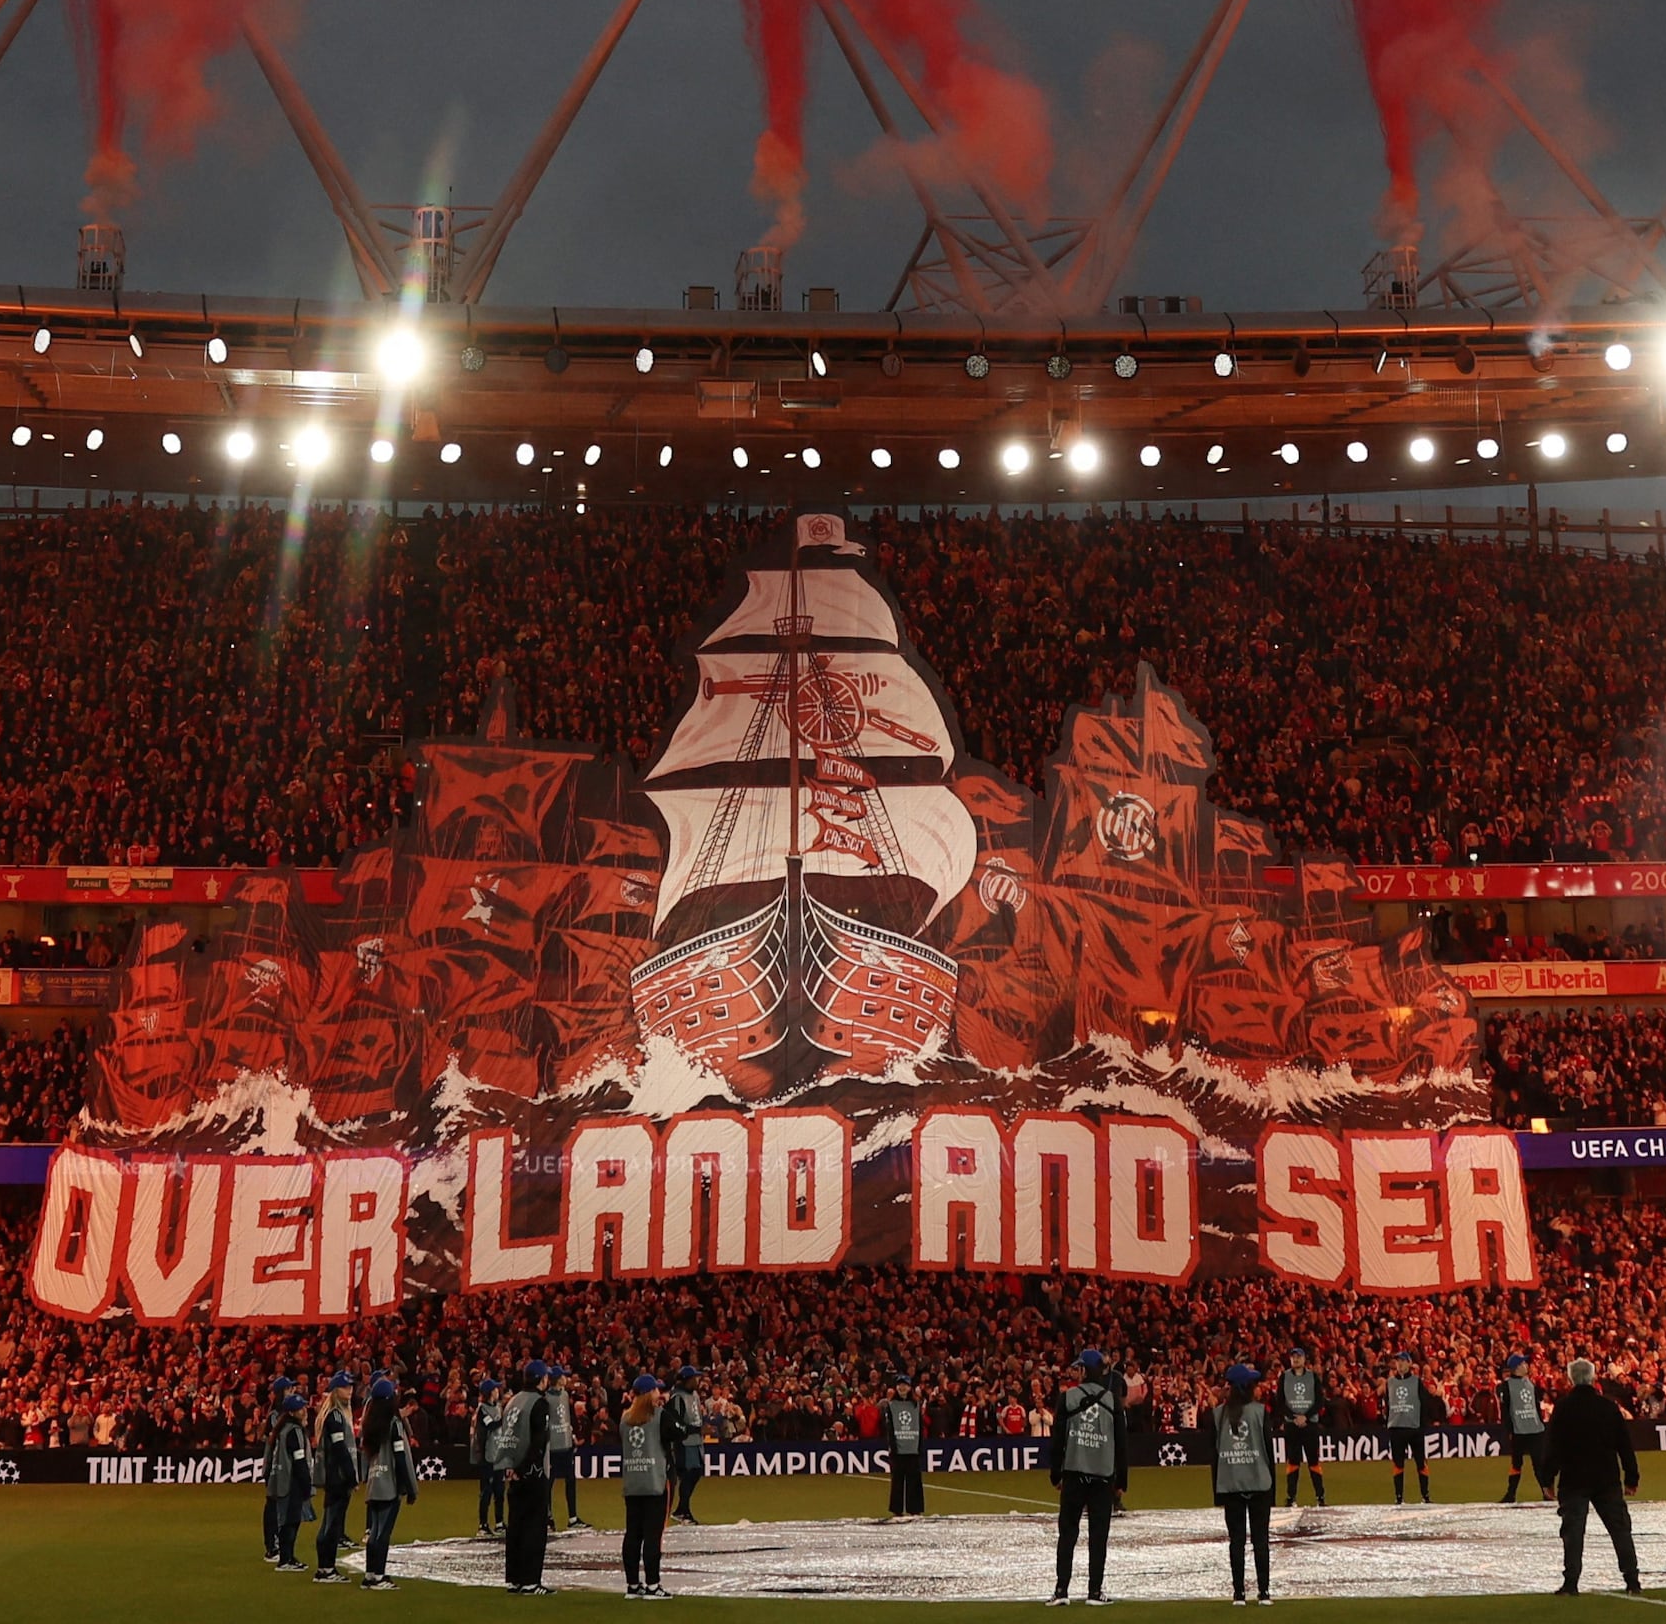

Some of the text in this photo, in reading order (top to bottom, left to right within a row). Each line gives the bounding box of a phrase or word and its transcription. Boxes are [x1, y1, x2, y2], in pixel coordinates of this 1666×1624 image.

[821, 758, 864, 782] VICTORIA
[823, 828, 866, 854] CRESCIT
[73, 879, 169, 890] Arsenal Bulgaria
[1356, 874, 1395, 894] 07
[1526, 967, 1605, 991] Liberia
[1571, 1137, 1629, 1159] UEFA
[32, 1109, 1536, 1322] OVER LAND AND SEA
[703, 1449, 891, 1477] HAMPIONS
[926, 1446, 1040, 1473] EAGUE
[1219, 1449, 1260, 1459] CHAMPIONS
[1227, 1457, 1254, 1465] LEAGUE
[86, 1456, 147, 1484] THAT
